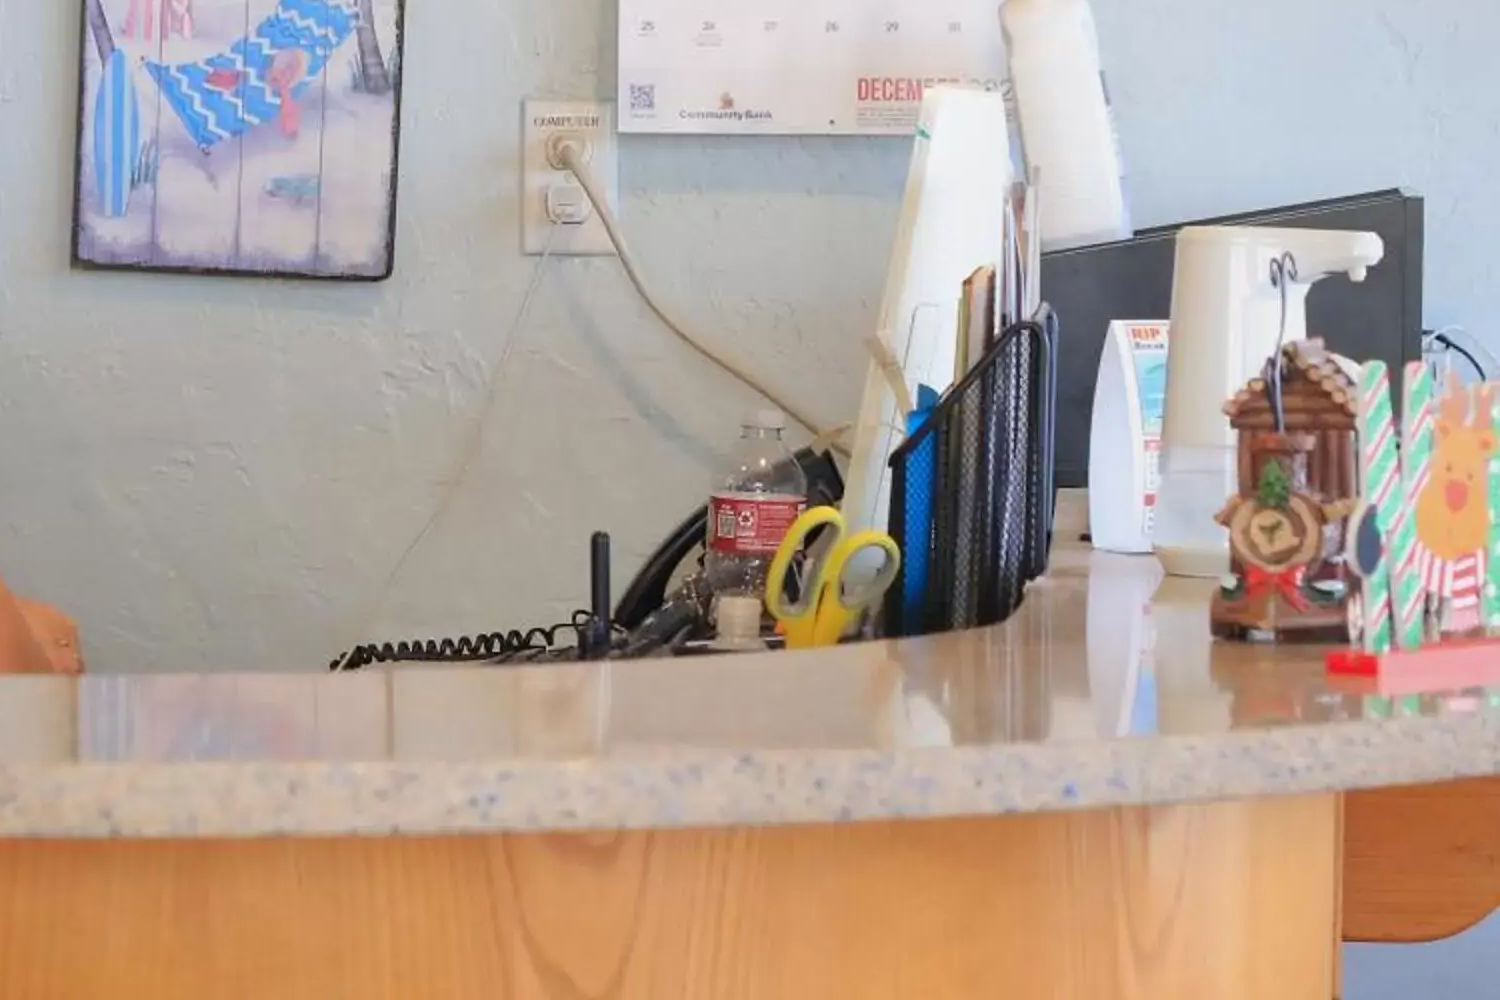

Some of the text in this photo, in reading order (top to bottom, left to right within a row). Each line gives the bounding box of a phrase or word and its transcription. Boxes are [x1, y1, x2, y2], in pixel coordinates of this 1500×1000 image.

[640, 20, 656, 32] 25
[824, 20, 840, 33] 28
[885, 21, 900, 33] 29
[678, 108, 773, 121] Community Bank
[532, 115, 601, 129] COMPUTER
